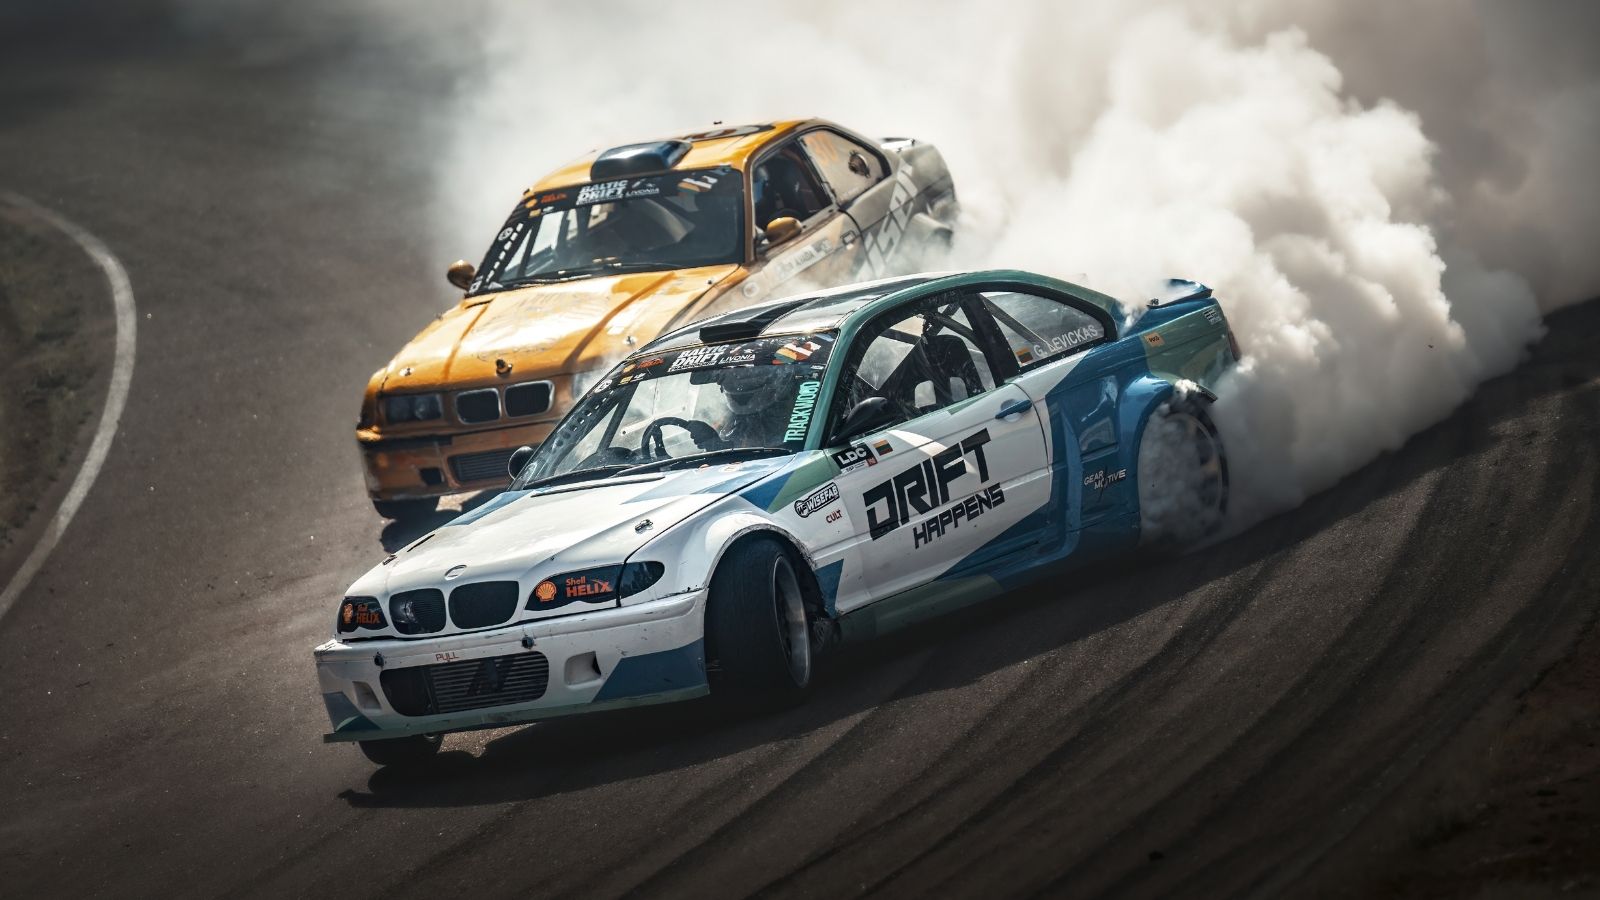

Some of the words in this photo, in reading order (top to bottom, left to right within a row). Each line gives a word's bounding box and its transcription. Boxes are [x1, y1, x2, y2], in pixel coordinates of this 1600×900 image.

[578, 187, 626, 201] DRIFT
[580, 180, 628, 193] BALTIC
[1033, 345, 1047, 357] G.
[1048, 325, 1099, 353] LEVICKAS
[673, 352, 725, 367] DRIFT
[679, 345, 730, 359] BALTIC
[719, 354, 756, 364] LIVONIA
[783, 381, 821, 443] TRACKWOOD
[838, 447, 867, 465] LDC
[863, 427, 992, 541] DRIFT
[1084, 470, 1104, 486] GEAR
[1094, 468, 1127, 490] MOTIVE
[807, 485, 839, 512] WISEFAB
[826, 509, 843, 524] CULT
[912, 482, 1006, 549] HAPPENS
[565, 575, 586, 587] Shell
[566, 579, 613, 598] HELIX
[357, 611, 381, 625] HELIX
[435, 651, 460, 661] PULL
